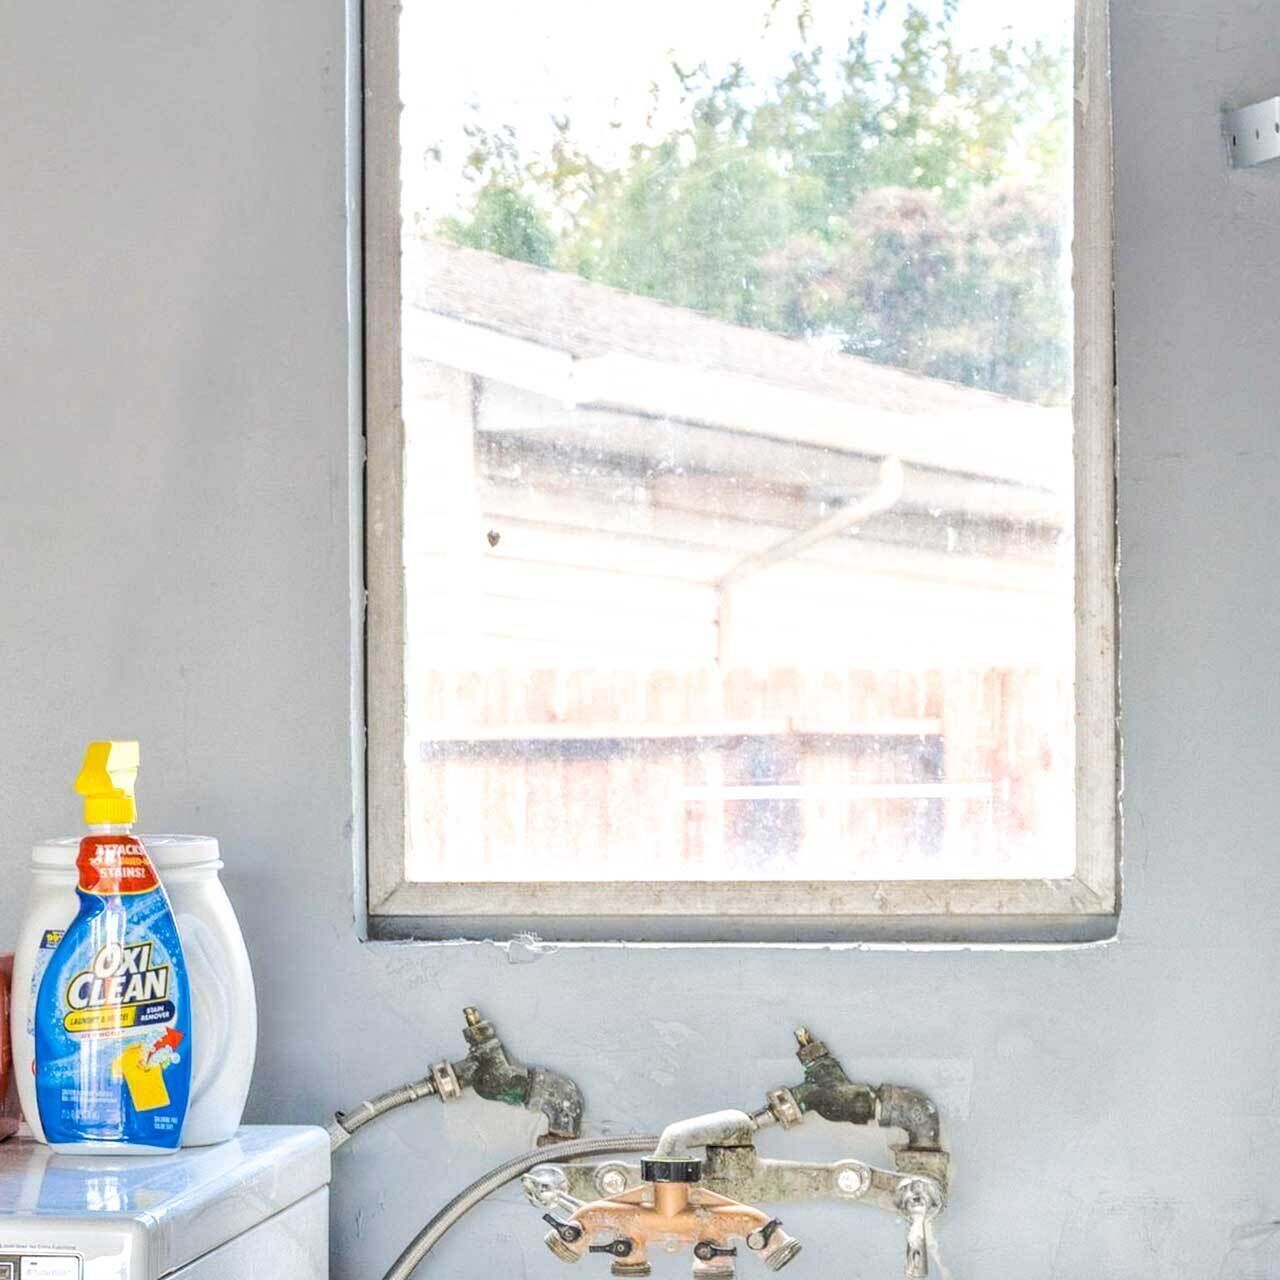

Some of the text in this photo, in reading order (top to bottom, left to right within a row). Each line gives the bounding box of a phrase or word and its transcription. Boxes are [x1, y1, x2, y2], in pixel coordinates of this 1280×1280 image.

[94, 943, 150, 979] OXI
[68, 968, 168, 1010] CLEAN
[140, 1011, 170, 1022] REMOVER
